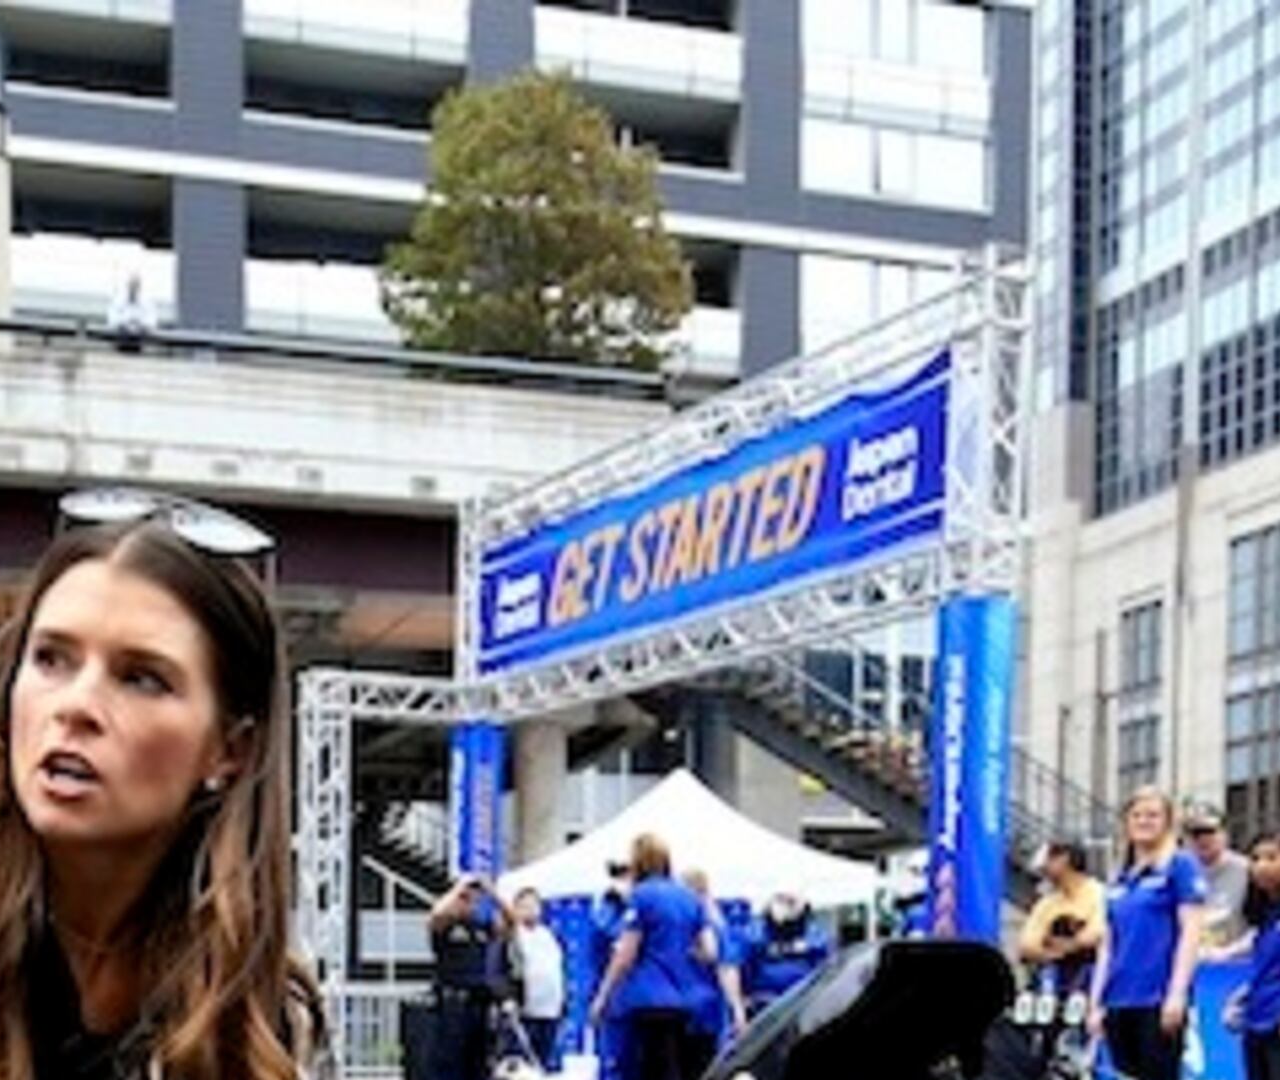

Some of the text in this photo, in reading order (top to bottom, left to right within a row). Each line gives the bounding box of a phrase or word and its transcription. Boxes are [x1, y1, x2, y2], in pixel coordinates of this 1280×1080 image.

[547, 443, 826, 628] GET STARTED
[840, 458, 917, 522] Dental
